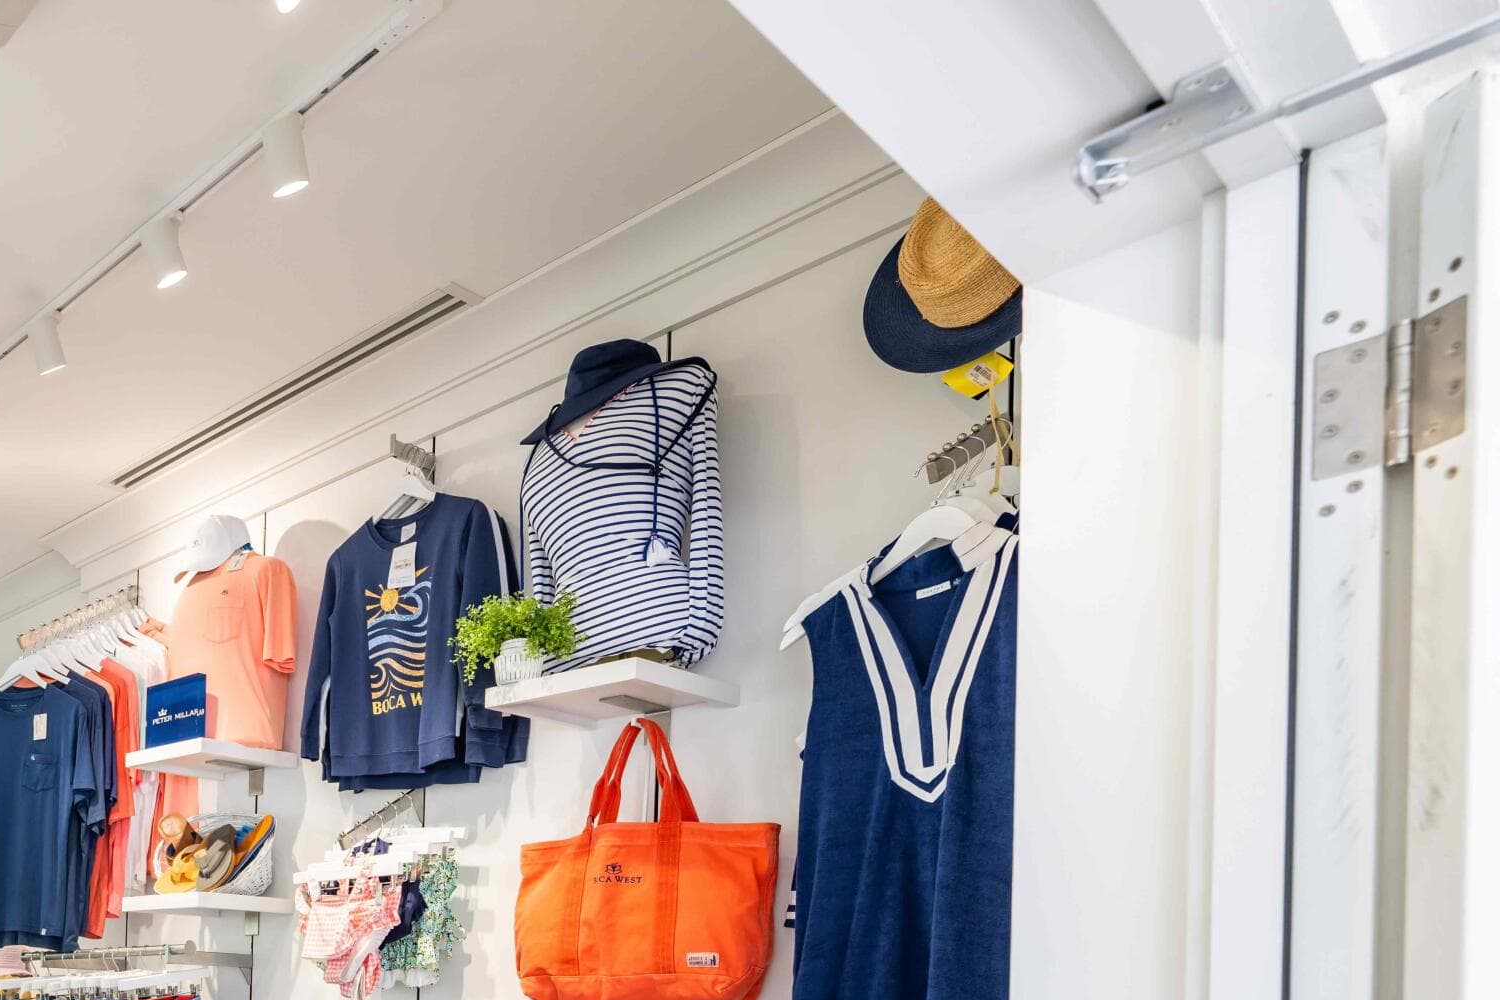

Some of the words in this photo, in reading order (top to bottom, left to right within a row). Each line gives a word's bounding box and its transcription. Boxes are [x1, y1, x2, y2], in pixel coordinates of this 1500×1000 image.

[372, 693, 406, 716] BOCA
[151, 714, 173, 726] PETER
[615, 875, 643, 884] WEST
